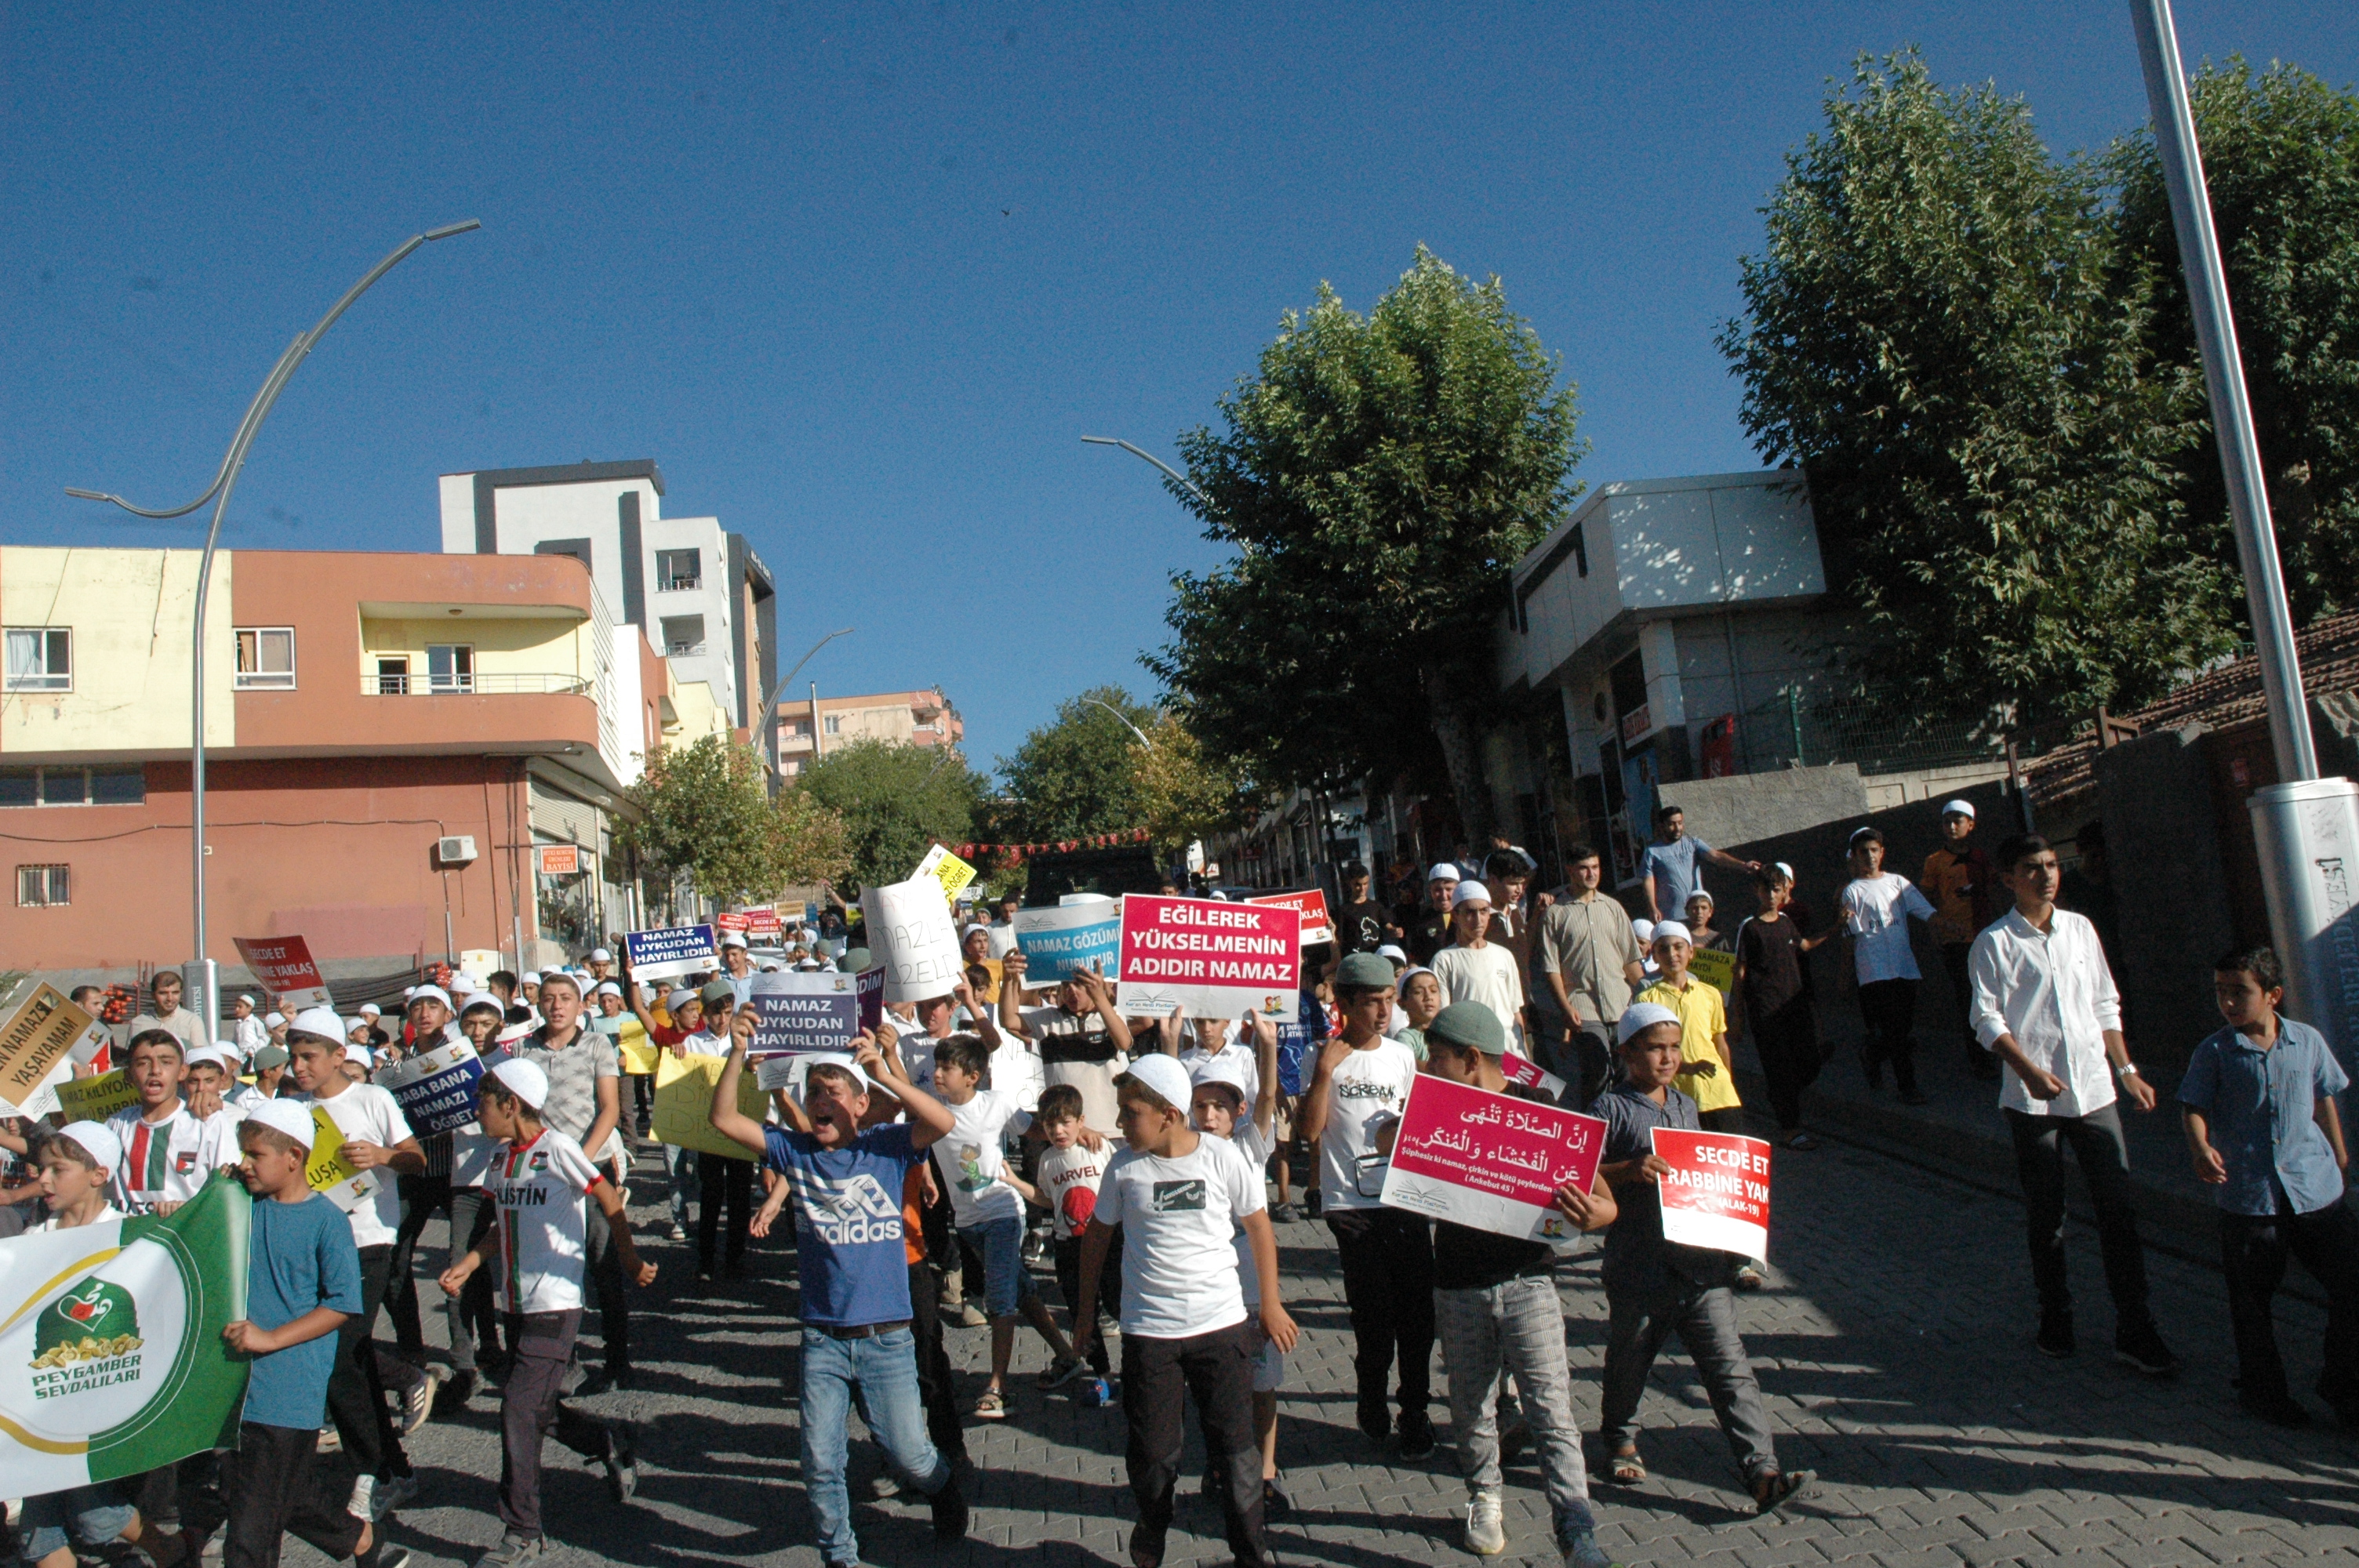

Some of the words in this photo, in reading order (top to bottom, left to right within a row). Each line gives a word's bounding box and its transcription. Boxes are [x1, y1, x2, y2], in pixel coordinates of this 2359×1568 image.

[546, 862, 574, 871] BAYİSİ
[1159, 904, 1261, 930] EĞİLEREK
[635, 936, 705, 953] UYKUDAN
[642, 928, 695, 942] NAMAZ
[1027, 936, 1072, 953] NAMAZ
[1131, 928, 1286, 956] YÜKSELMENİN
[274, 946, 287, 959] ET
[635, 946, 713, 965] HAYIRLIDIR
[274, 962, 314, 977] YAKLAŞ
[1128, 957, 1205, 978] ADIDIR
[1209, 960, 1292, 982] NAMAZ
[765, 999, 832, 1012] NAMAZ
[757, 1017, 843, 1029] UYKUDAN
[11, 1016, 79, 1087] YAŞAYAMAM
[754, 1033, 851, 1047] HAYIRLIDIR
[394, 1085, 431, 1105] BABA
[429, 1069, 473, 1094] BANA
[413, 1090, 469, 1118] NAMAZI
[431, 1108, 474, 1131] ÖĞRET
[1401, 1146, 1434, 1162] Şüphesiz
[1441, 1159, 1467, 1171] namaz,
[1468, 1165, 1488, 1177] çirkin
[1695, 1145, 1751, 1171] SECDE
[1753, 1154, 1769, 1176] ET
[1668, 1167, 1743, 1196] RABBİNE
[814, 1218, 901, 1245] adidas
[31, 1354, 142, 1387] PEYGAMBER
[35, 1368, 141, 1400] SEVDALILARI
